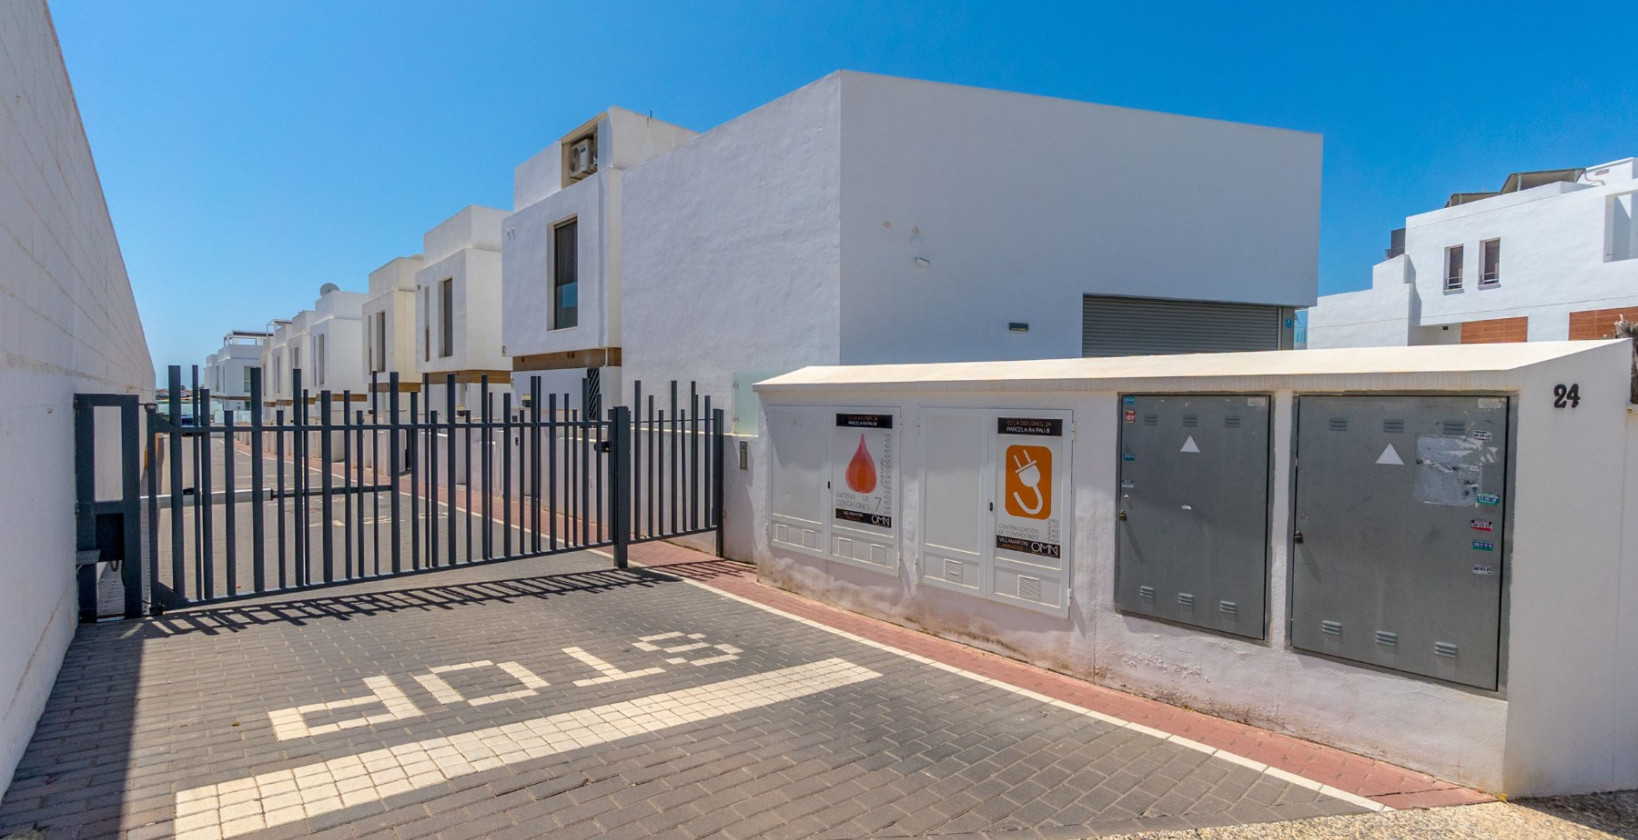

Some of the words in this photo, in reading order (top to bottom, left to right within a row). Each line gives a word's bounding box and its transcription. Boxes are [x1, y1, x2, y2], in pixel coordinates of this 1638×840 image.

[1554, 383, 1581, 408] 24
[874, 496, 881, 511] 7
[268, 631, 744, 741] STOP
